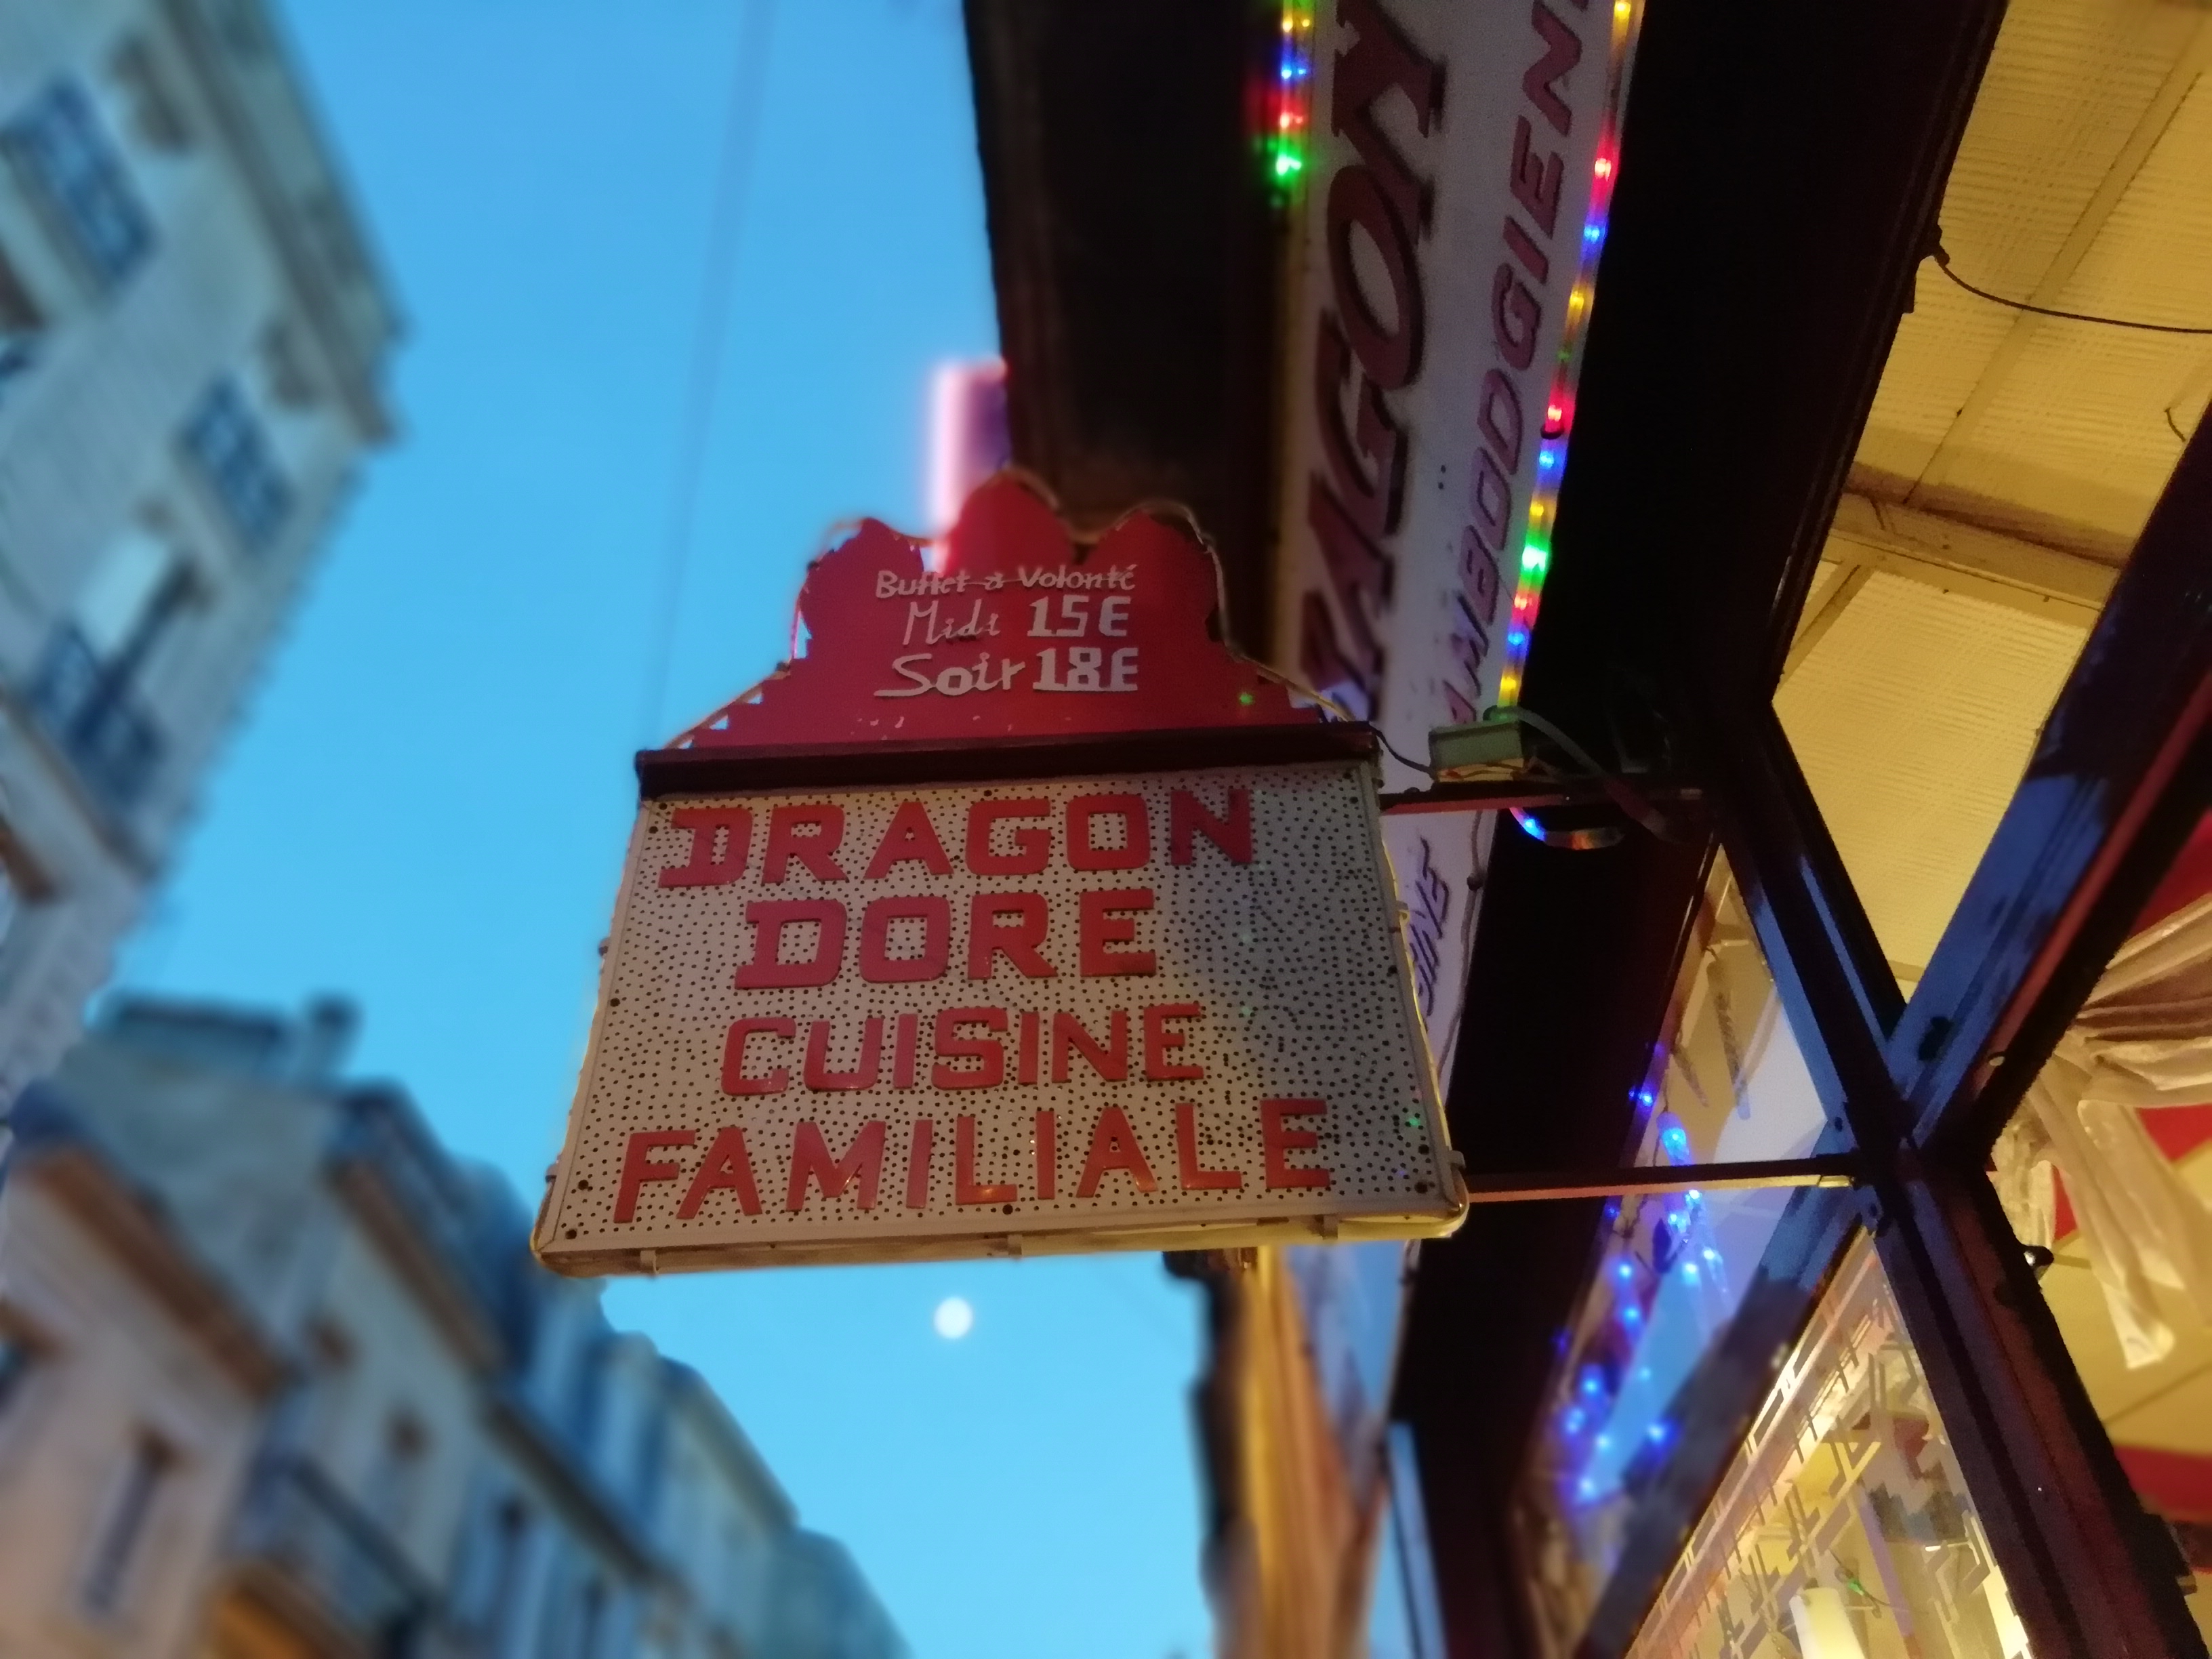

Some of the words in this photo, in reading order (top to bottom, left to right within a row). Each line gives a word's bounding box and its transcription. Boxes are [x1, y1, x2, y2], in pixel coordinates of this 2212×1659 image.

[876, 568, 970, 598] Buffet
[1018, 564, 1138, 590] Volonté
[903, 598, 1001, 645] Midi
[874, 652, 1025, 697] Soir
[658, 788, 1252, 888] DRAGON
[734, 888, 1157, 989] DORE
[720, 1003, 1204, 1096] CUISINE
[613, 1098, 1330, 1223] FAMILIALE
